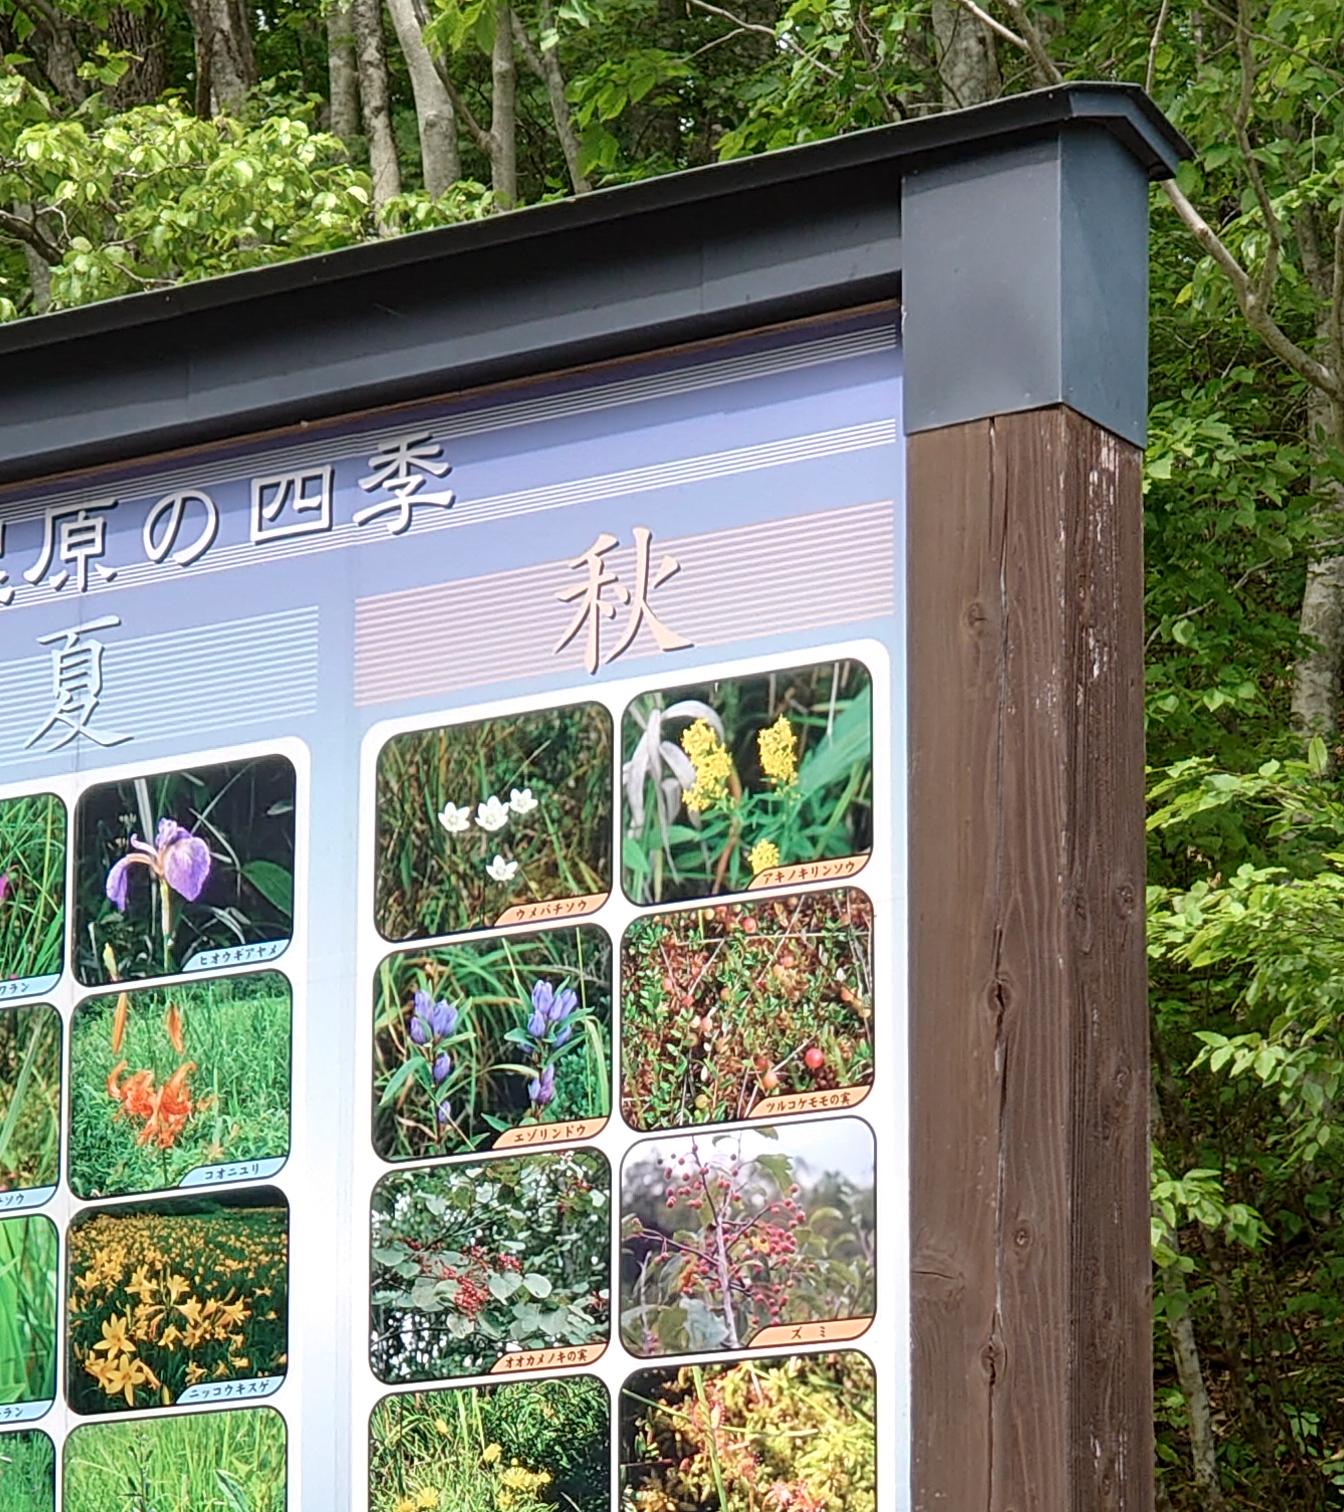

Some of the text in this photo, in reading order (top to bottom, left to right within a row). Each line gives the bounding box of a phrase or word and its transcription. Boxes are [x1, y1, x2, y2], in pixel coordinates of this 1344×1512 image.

[552, 527, 695, 675] 秋
[24, 613, 133, 755] 夏
[762, 861, 855, 883] アキノキリンソウ
[516, 900, 587, 920] ウメバチソウ
[200, 944, 278, 965] ヒオウギアヤメ
[766, 1092, 851, 1113] ツルコケモモの実
[514, 1124, 586, 1142] エゾリンドウ
[205, 1163, 259, 1180] コオニユリ
[505, 1349, 587, 1369] オオカメノキの実
[189, 1380, 269, 1398] ニッコウキスゲ
